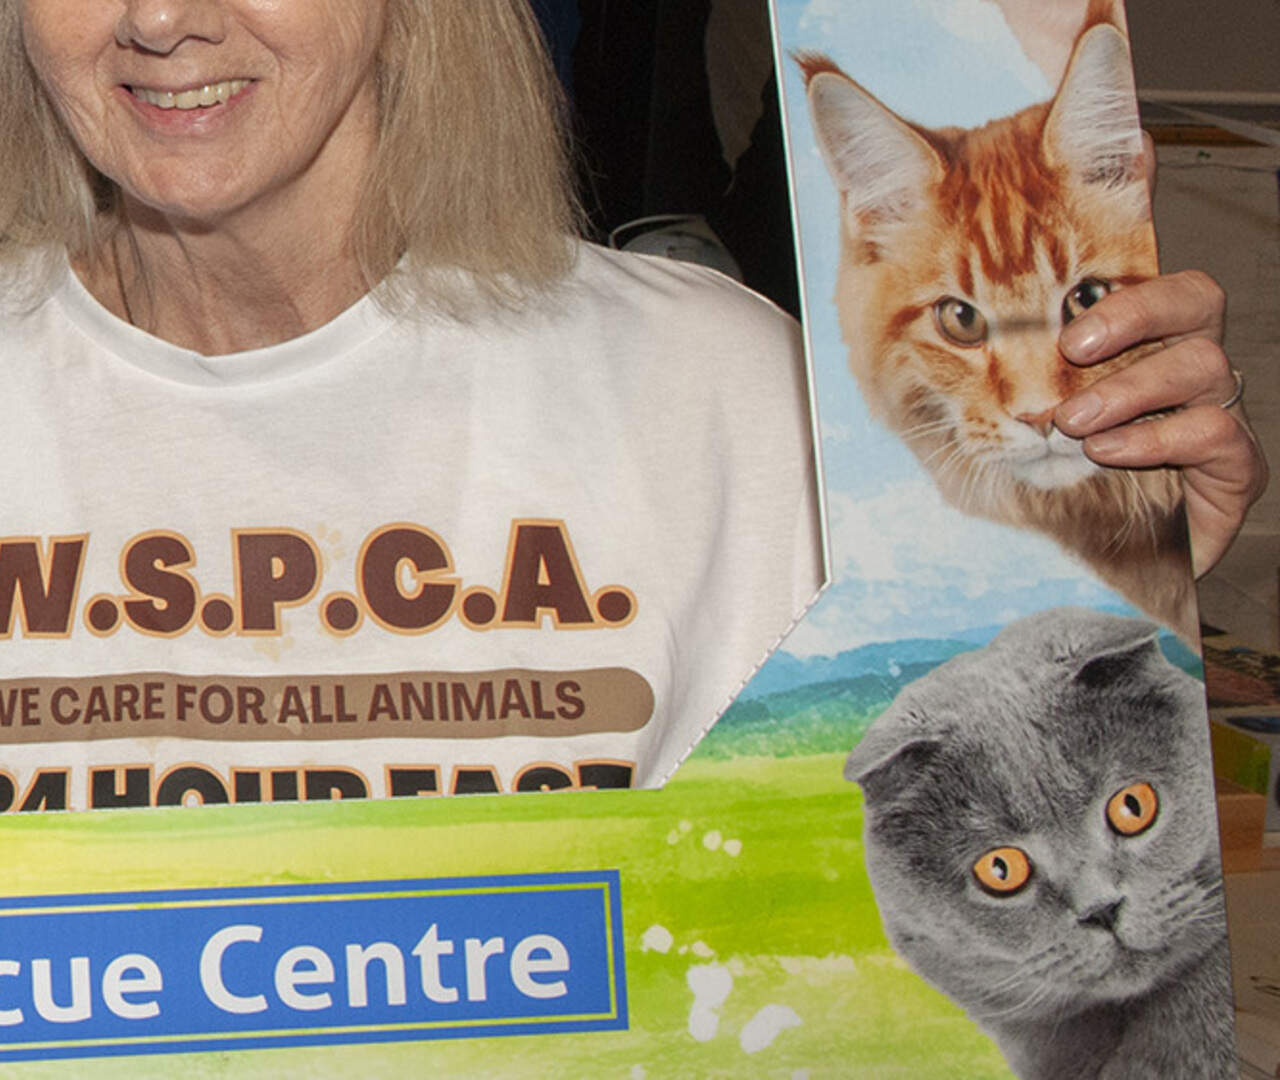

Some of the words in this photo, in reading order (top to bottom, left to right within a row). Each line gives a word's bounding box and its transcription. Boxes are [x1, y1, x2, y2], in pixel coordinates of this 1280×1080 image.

[50, 681, 165, 725] CARE
[175, 684, 266, 725] FOR
[275, 686, 358, 724] ALL
[367, 679, 586, 721] ANIMALS
[198, 923, 572, 1015] Centre
